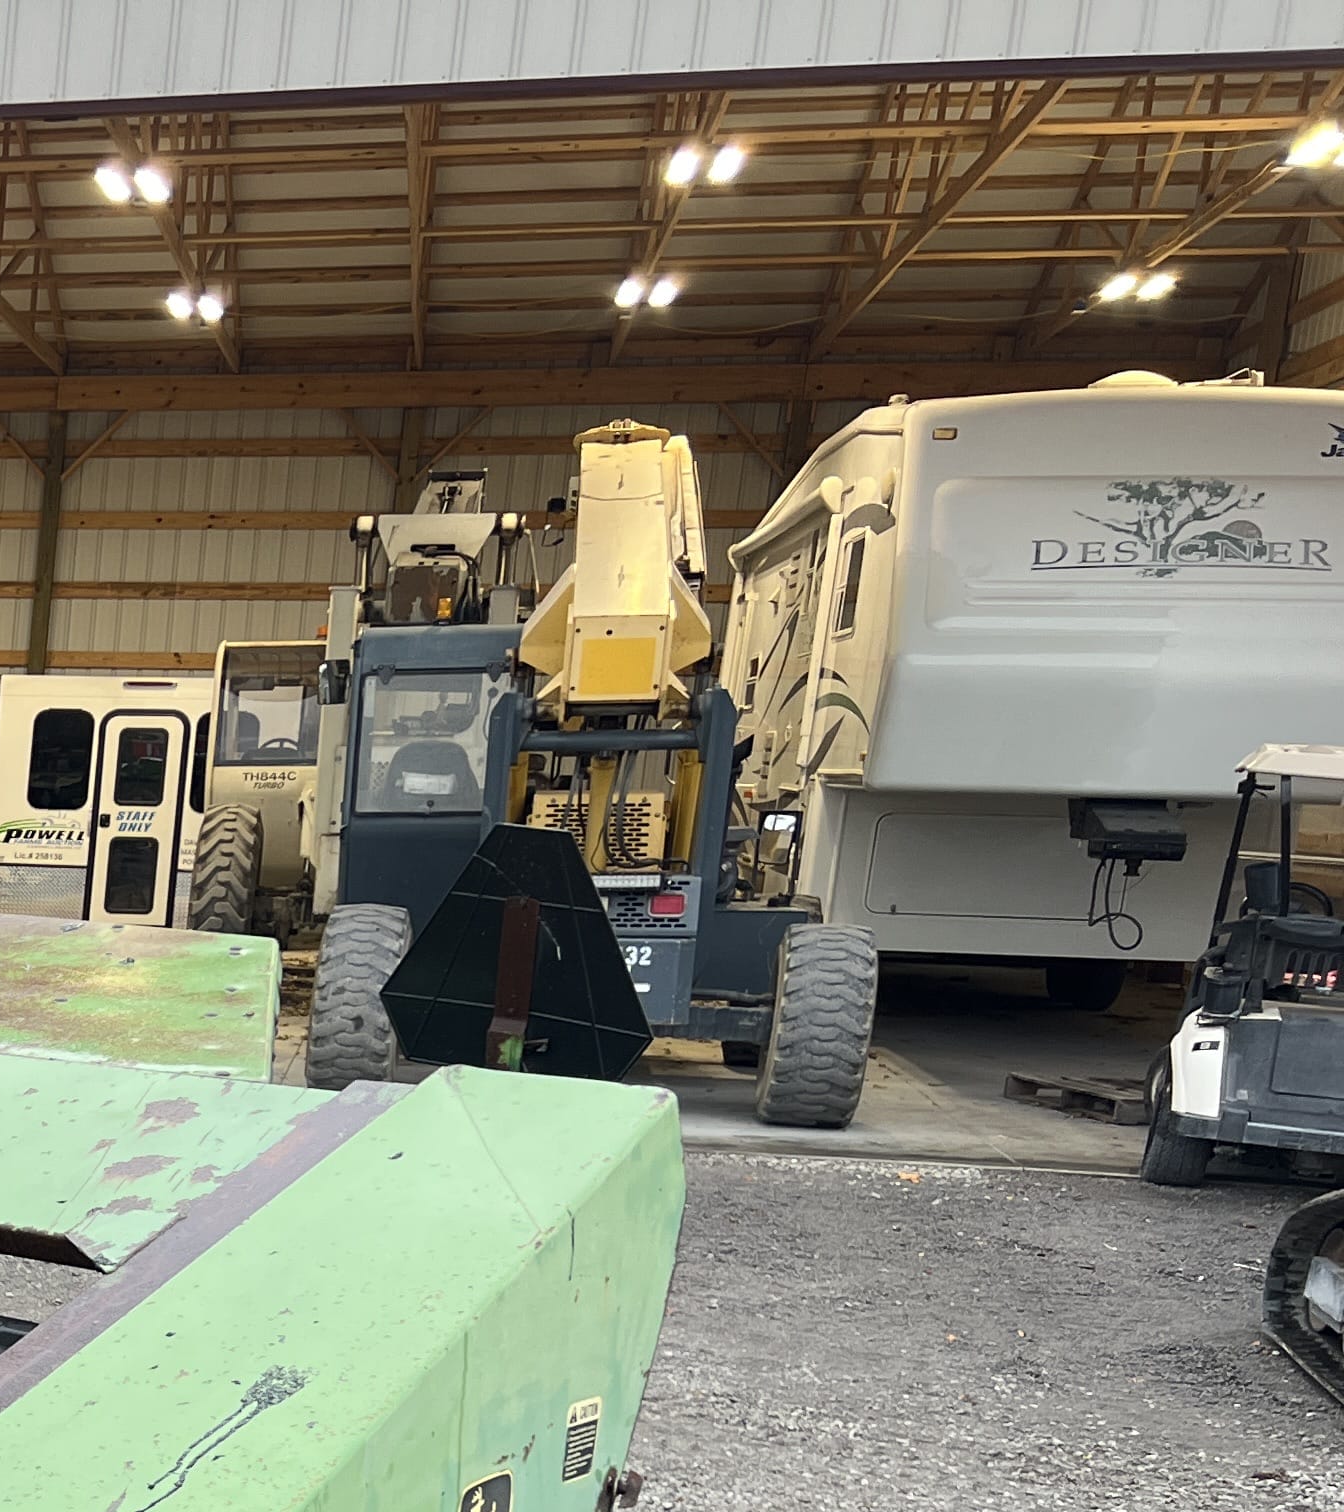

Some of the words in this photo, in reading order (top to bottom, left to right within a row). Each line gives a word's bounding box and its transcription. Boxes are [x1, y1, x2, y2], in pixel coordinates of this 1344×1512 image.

[1031, 538, 1331, 567] DESIGNER
[242, 771, 297, 781] TH844C
[253, 781, 285, 789] TURBO
[116, 811, 156, 821] STAFF
[118, 822, 152, 832] ONLY
[2, 828, 84, 843] POWELL
[618, 945, 653, 966] 32
